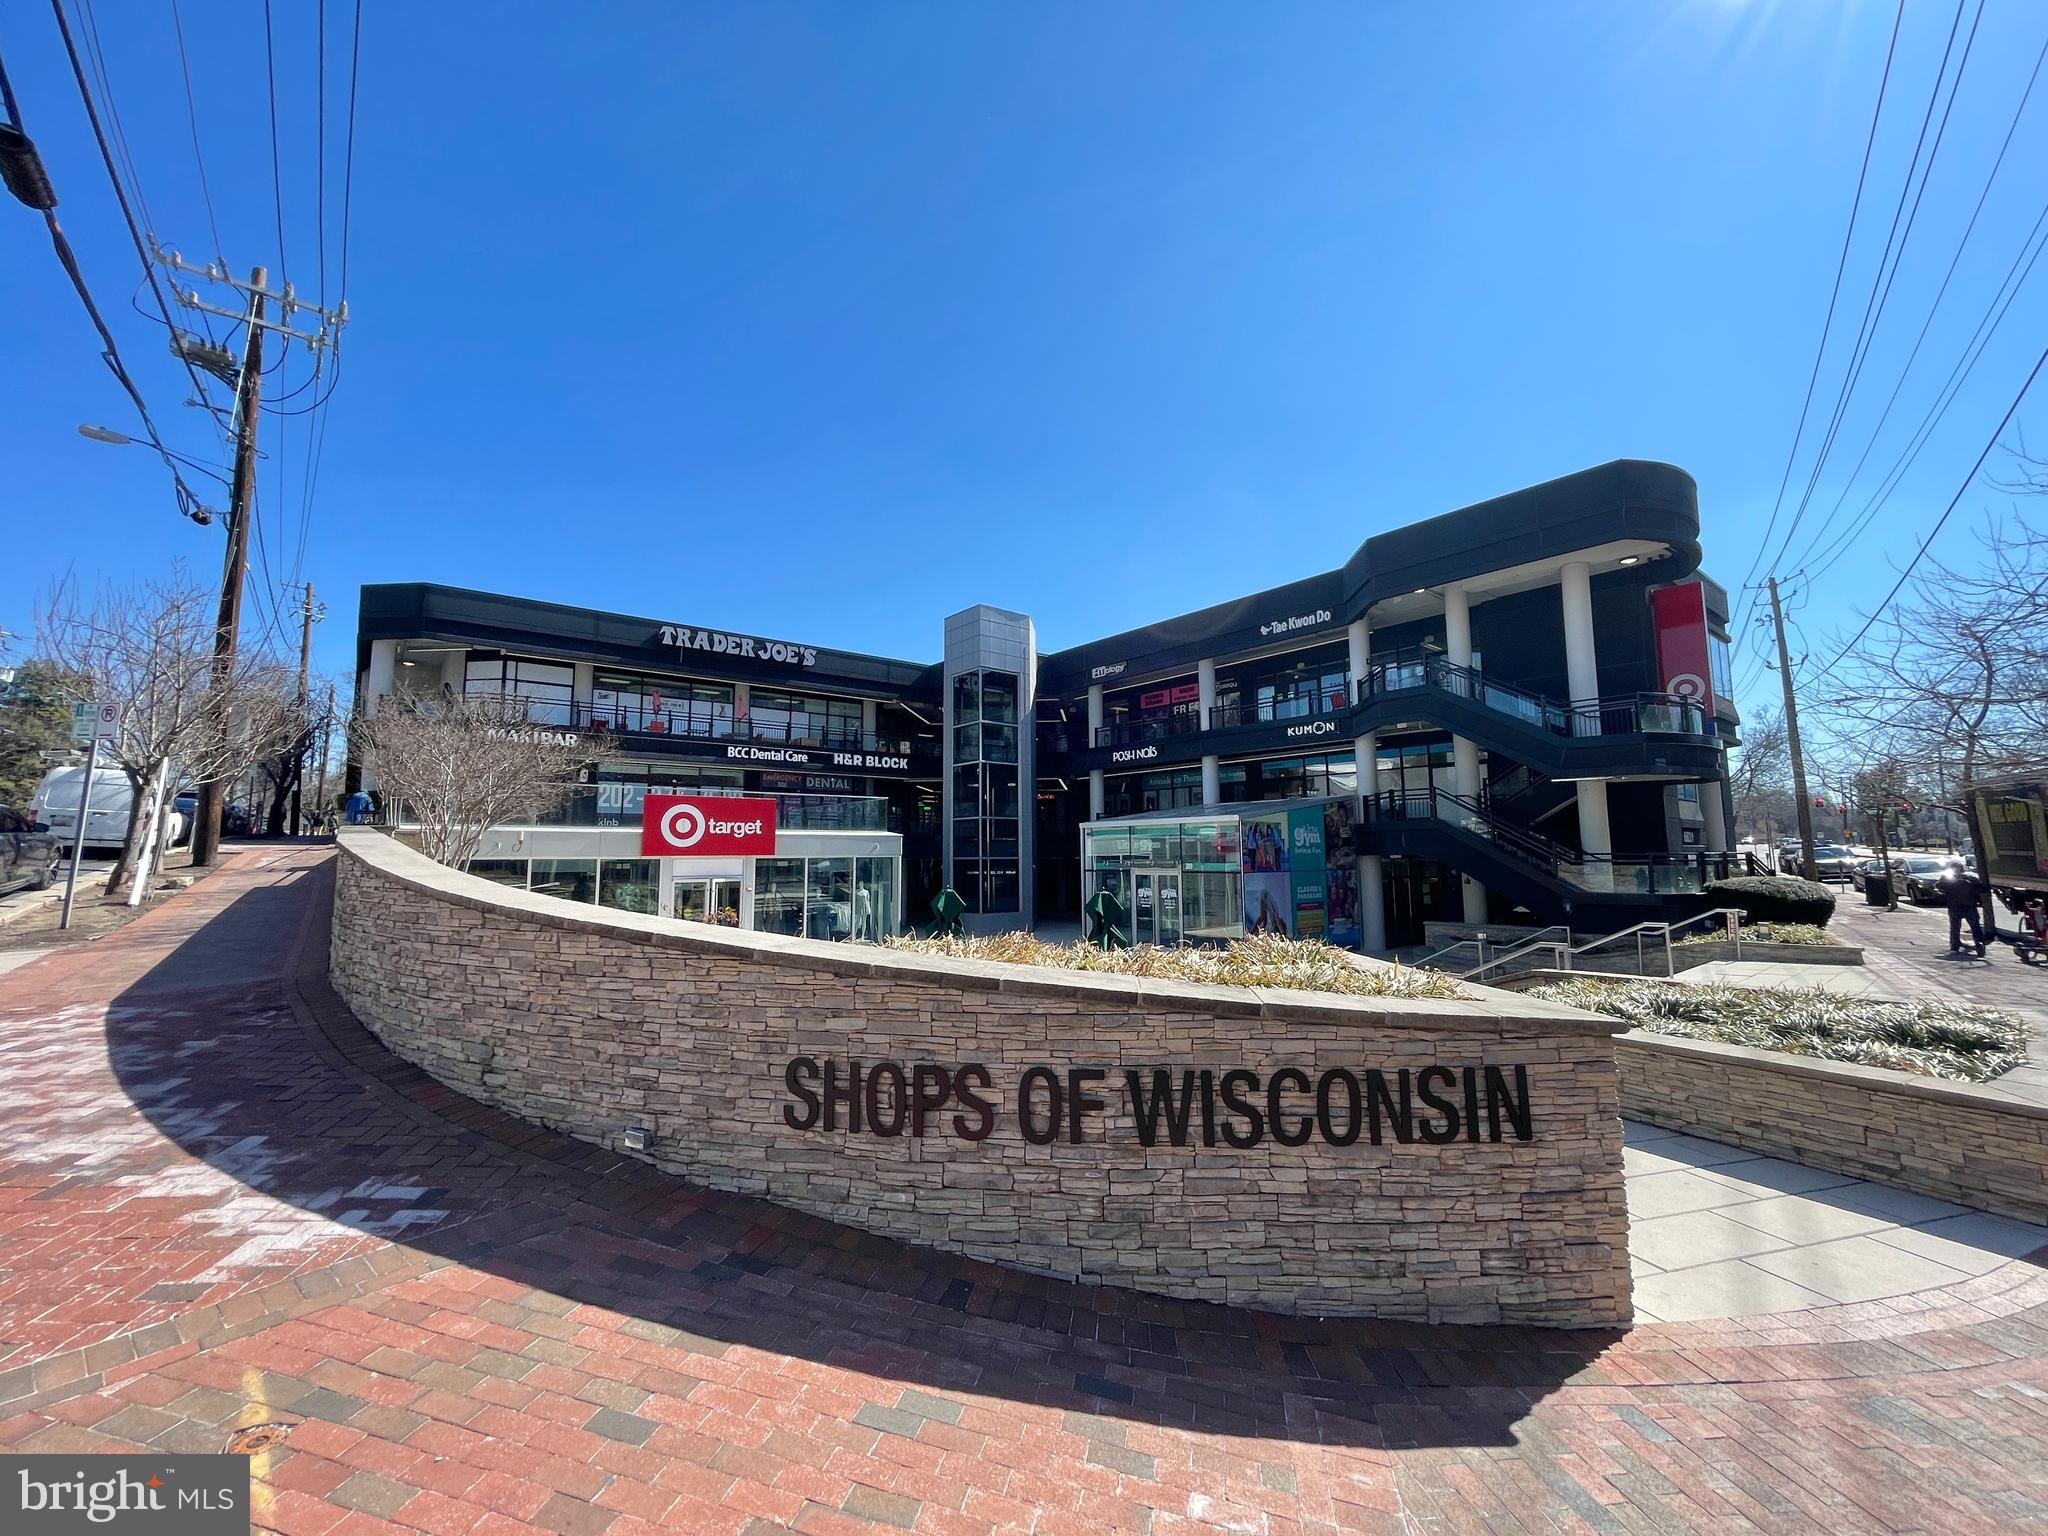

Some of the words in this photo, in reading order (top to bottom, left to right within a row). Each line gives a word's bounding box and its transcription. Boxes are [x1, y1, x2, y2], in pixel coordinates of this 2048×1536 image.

[1271, 622, 1288, 634] Tae
[1288, 616, 1316, 630] Kwon
[1317, 610, 1332, 623] Do
[659, 625, 756, 658] TRADER
[757, 642, 818, 667] JOE'S
[1287, 721, 1336, 737] KUMON
[727, 746, 749, 759] BCC
[751, 747, 784, 761] Dental
[785, 751, 809, 763] Care
[834, 753, 863, 766] H&R
[866, 755, 909, 769] BLOCK
[1113, 749, 1136, 762] POSH
[806, 776, 850, 789] DENTAL
[708, 818, 763, 838] target
[1294, 827, 1321, 847] gym
[783, 1056, 994, 1142] SHOPS
[1018, 1065, 1105, 1146] OF
[1125, 1064, 1533, 1149] WISCONSIN
